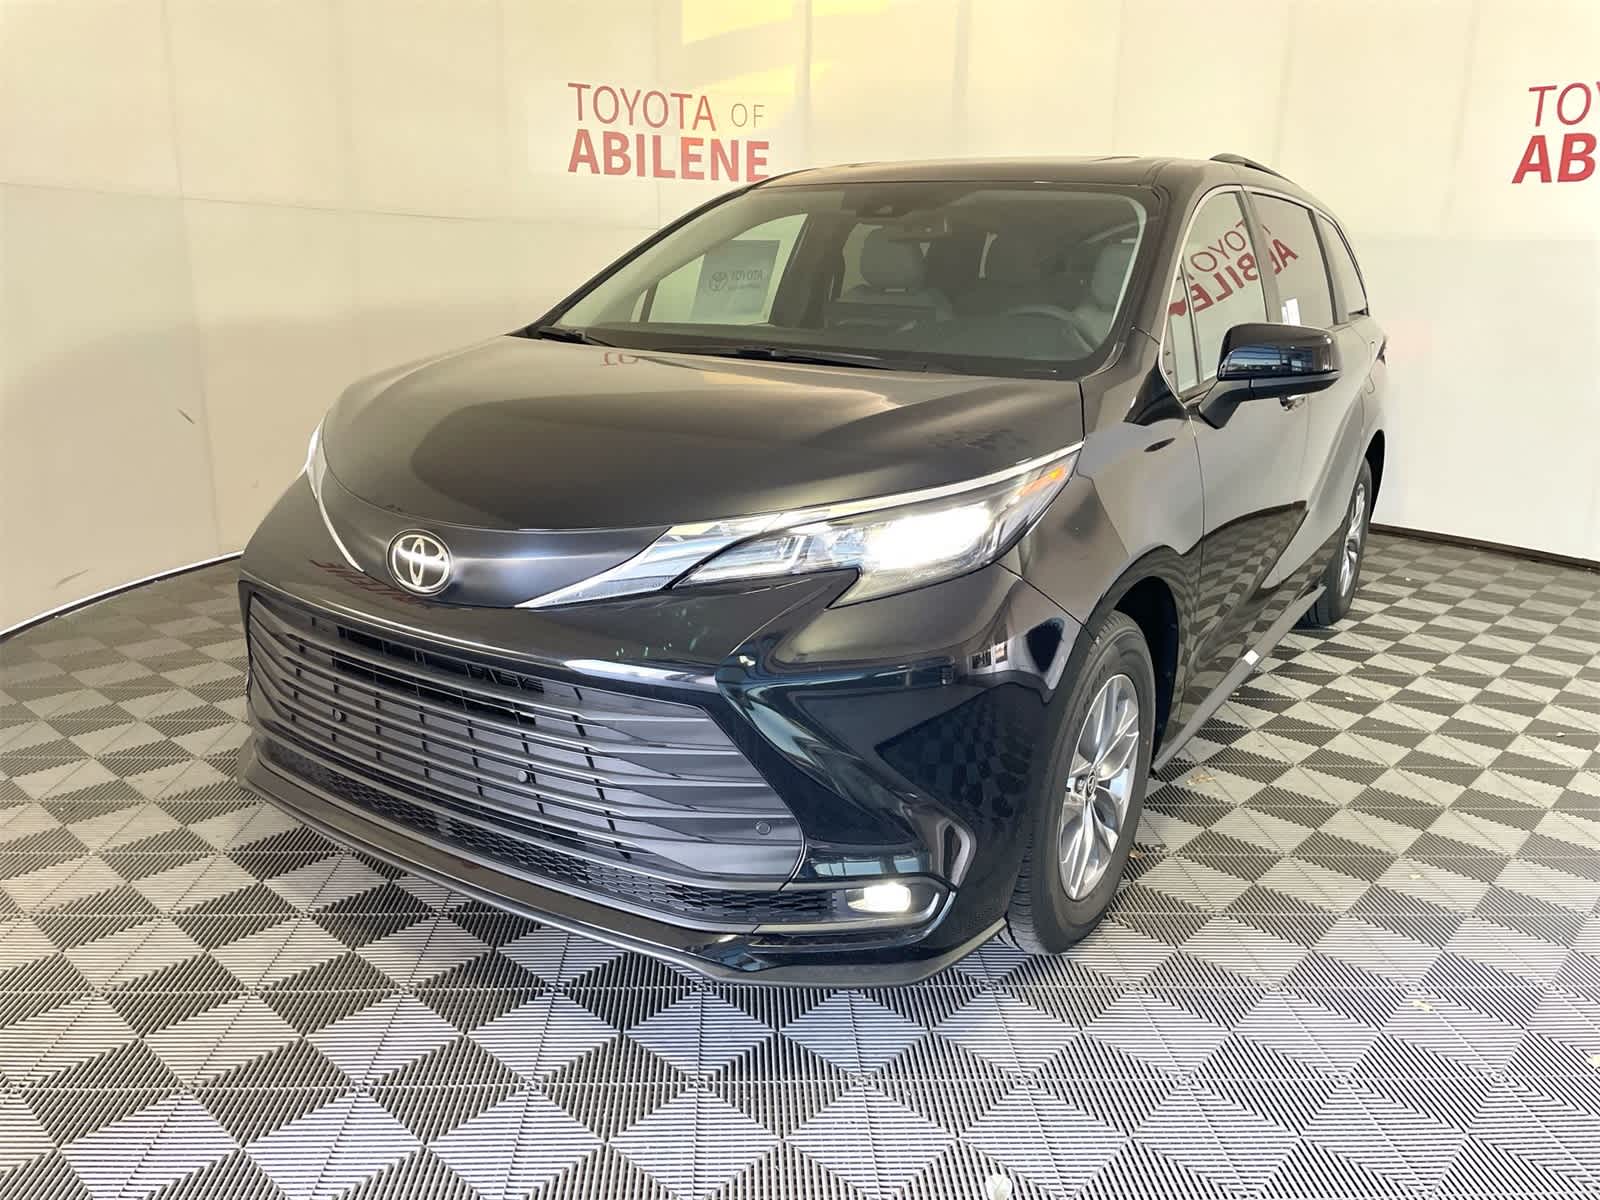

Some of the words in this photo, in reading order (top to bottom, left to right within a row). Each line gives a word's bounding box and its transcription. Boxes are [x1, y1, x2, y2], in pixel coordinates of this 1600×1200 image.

[568, 82, 716, 131] TOYOTA
[731, 103, 765, 128] OF
[1528, 81, 1600, 127] TO
[568, 128, 770, 183] ABILENE
